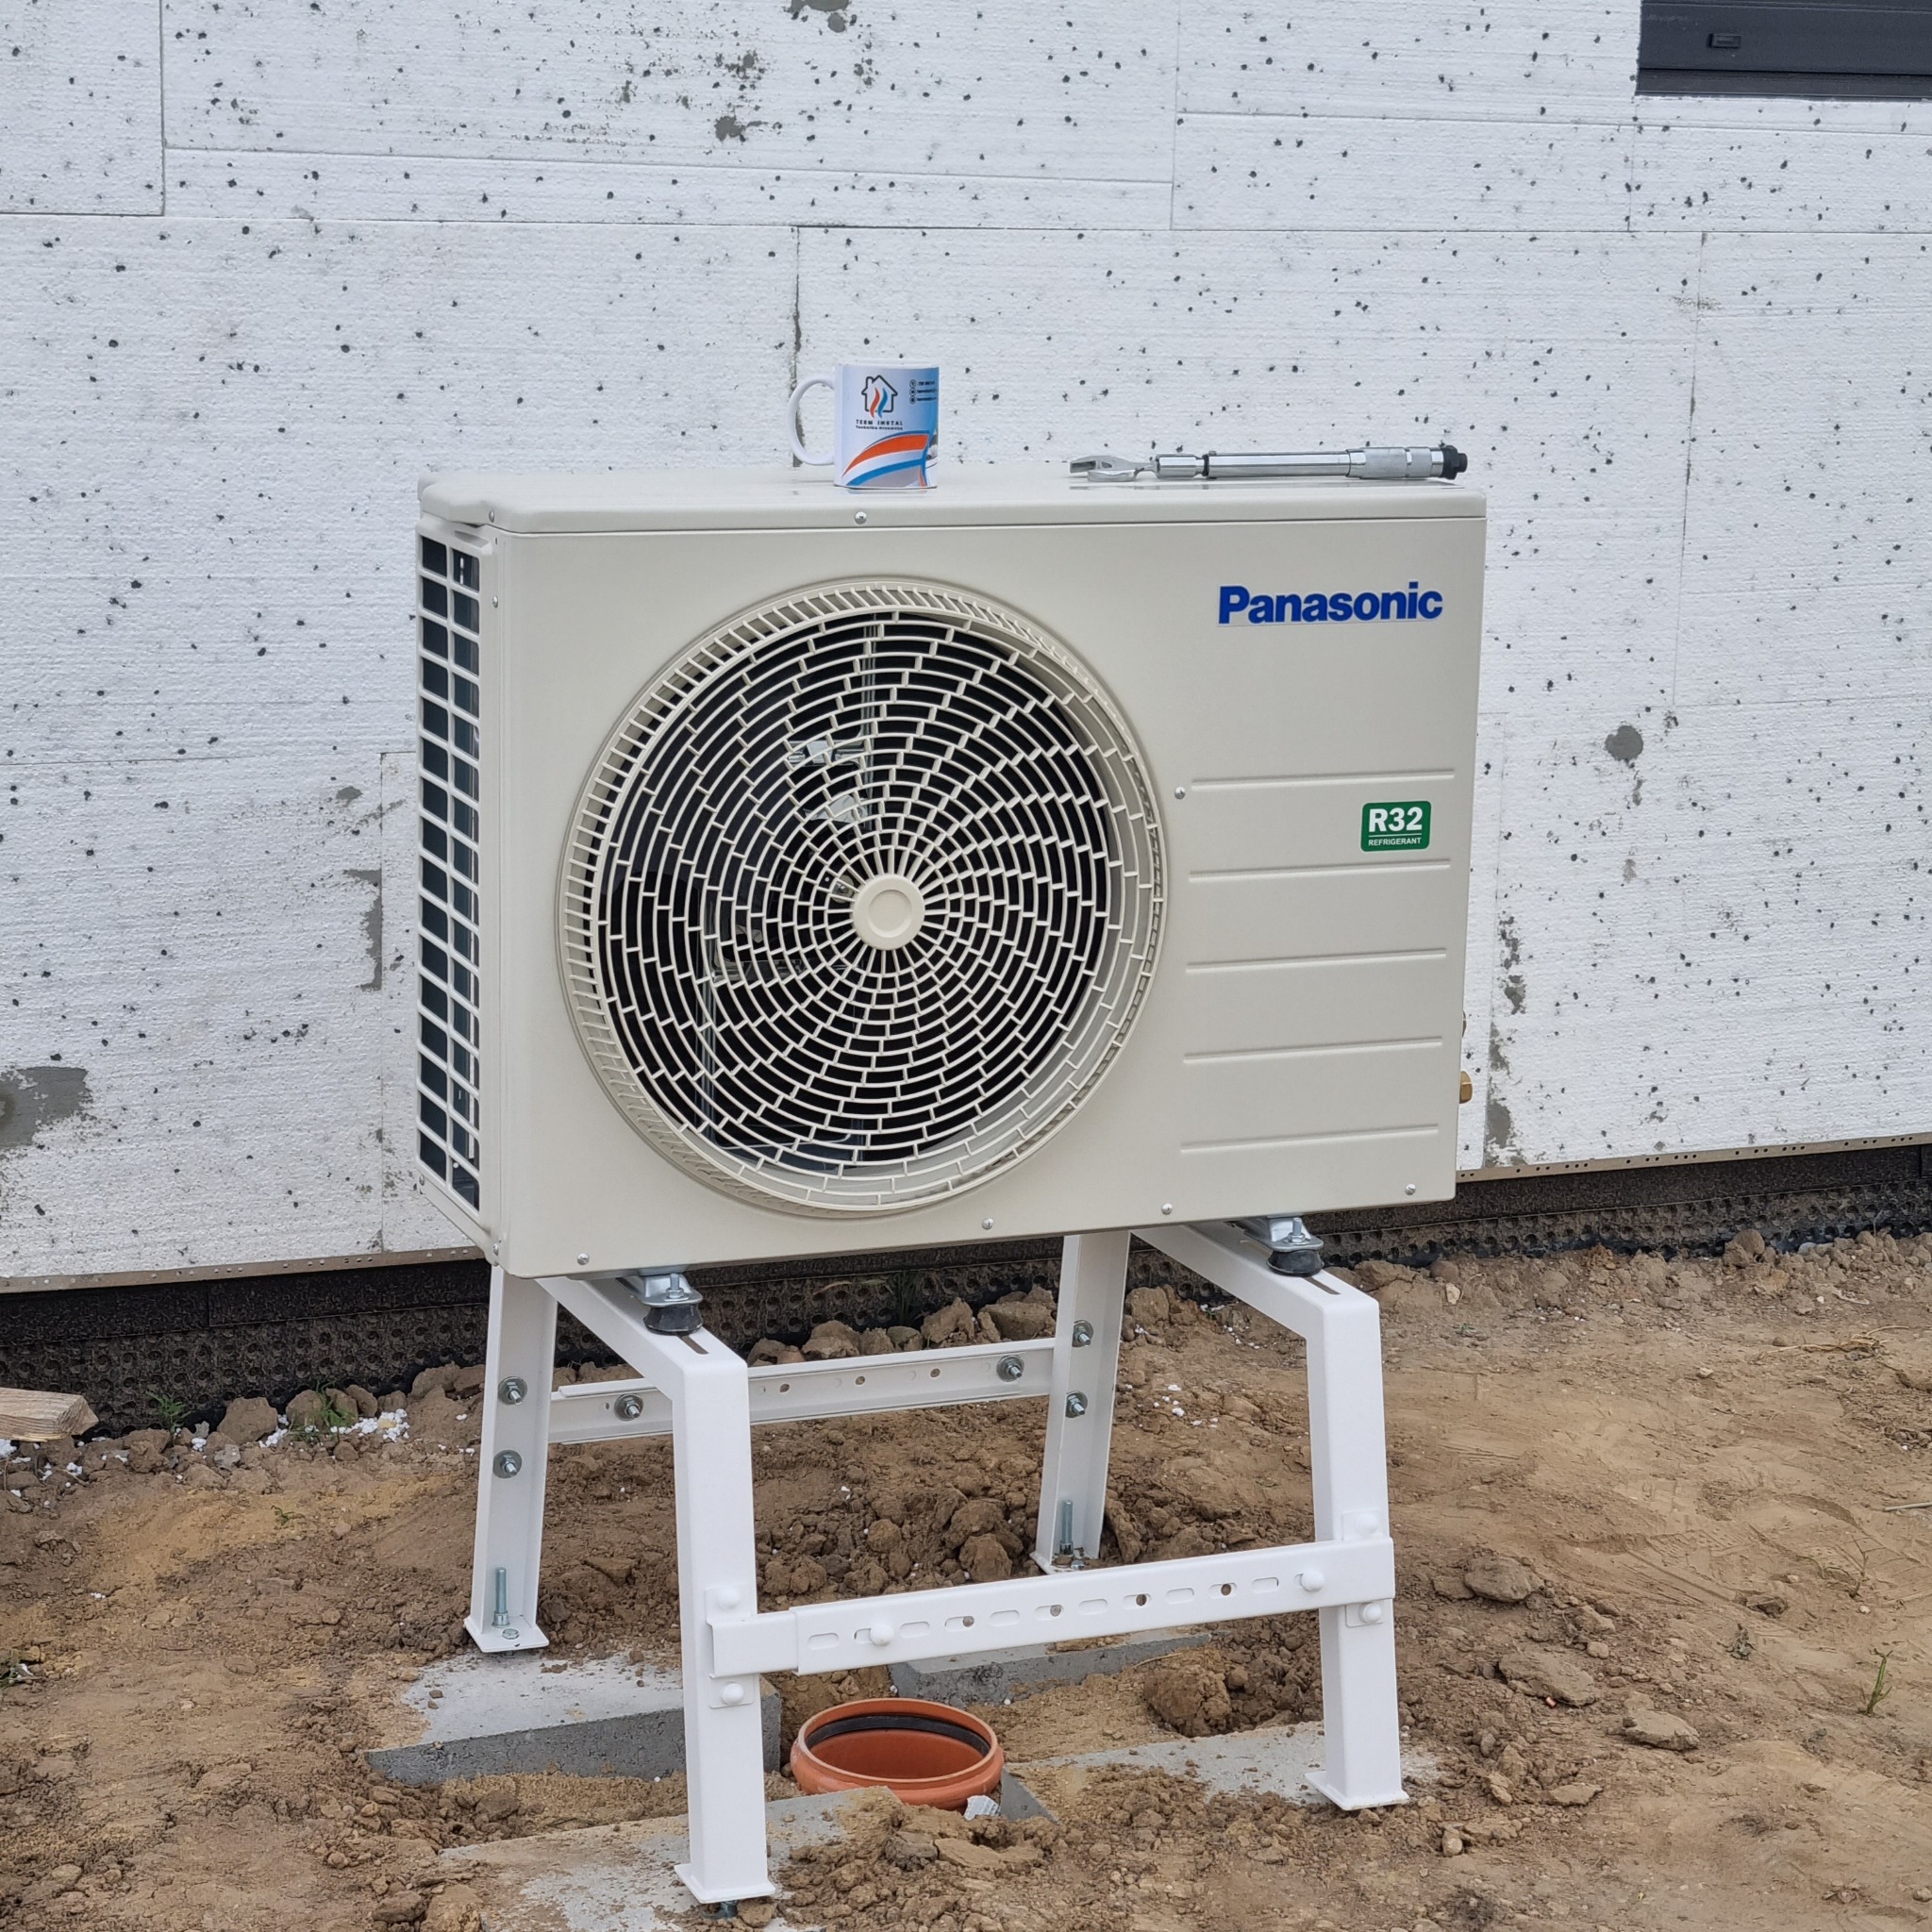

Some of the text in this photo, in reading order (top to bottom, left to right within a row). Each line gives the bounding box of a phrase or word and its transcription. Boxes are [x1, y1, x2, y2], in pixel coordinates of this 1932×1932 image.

[1218, 581, 1443, 625] Panasonic
[1368, 807, 1424, 833] R32
[1368, 837, 1422, 846] REFRIGERANT
